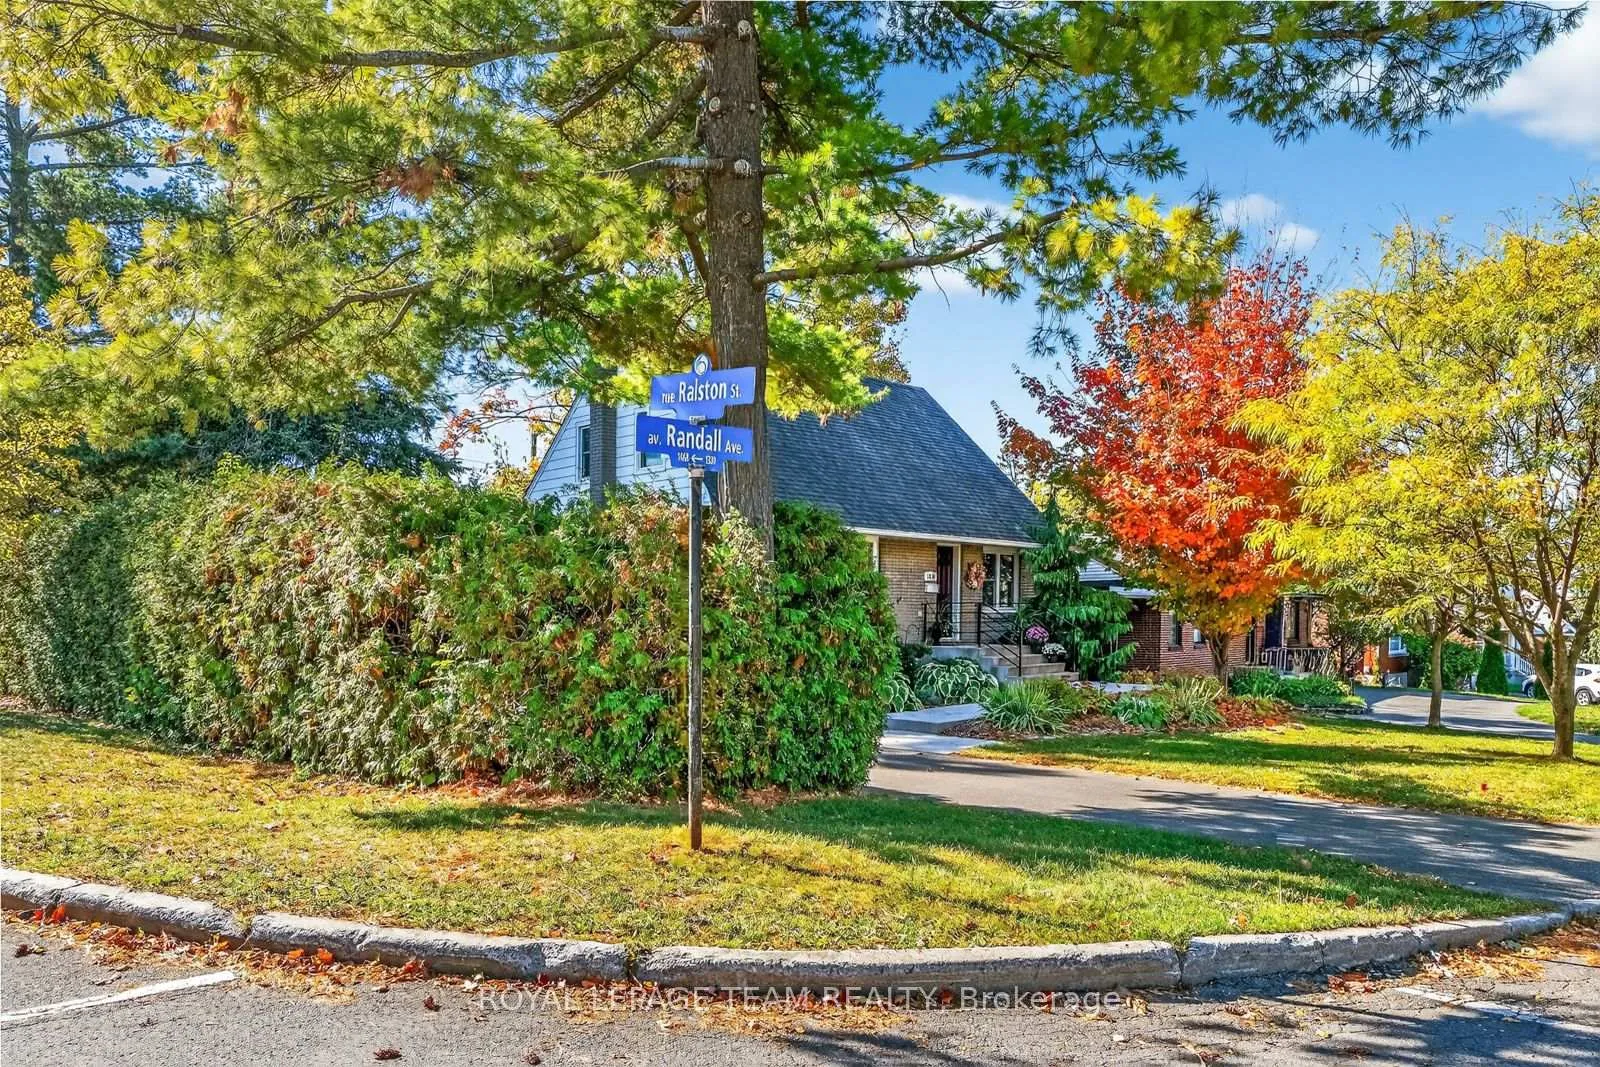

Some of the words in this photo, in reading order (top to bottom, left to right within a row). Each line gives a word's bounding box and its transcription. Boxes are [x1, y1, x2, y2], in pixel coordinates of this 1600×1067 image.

[661, 392, 676, 404] rue
[678, 378, 727, 403] Ralston
[647, 433, 662, 445] av.
[666, 424, 722, 452] Randall
[724, 440, 744, 455] Ave.
